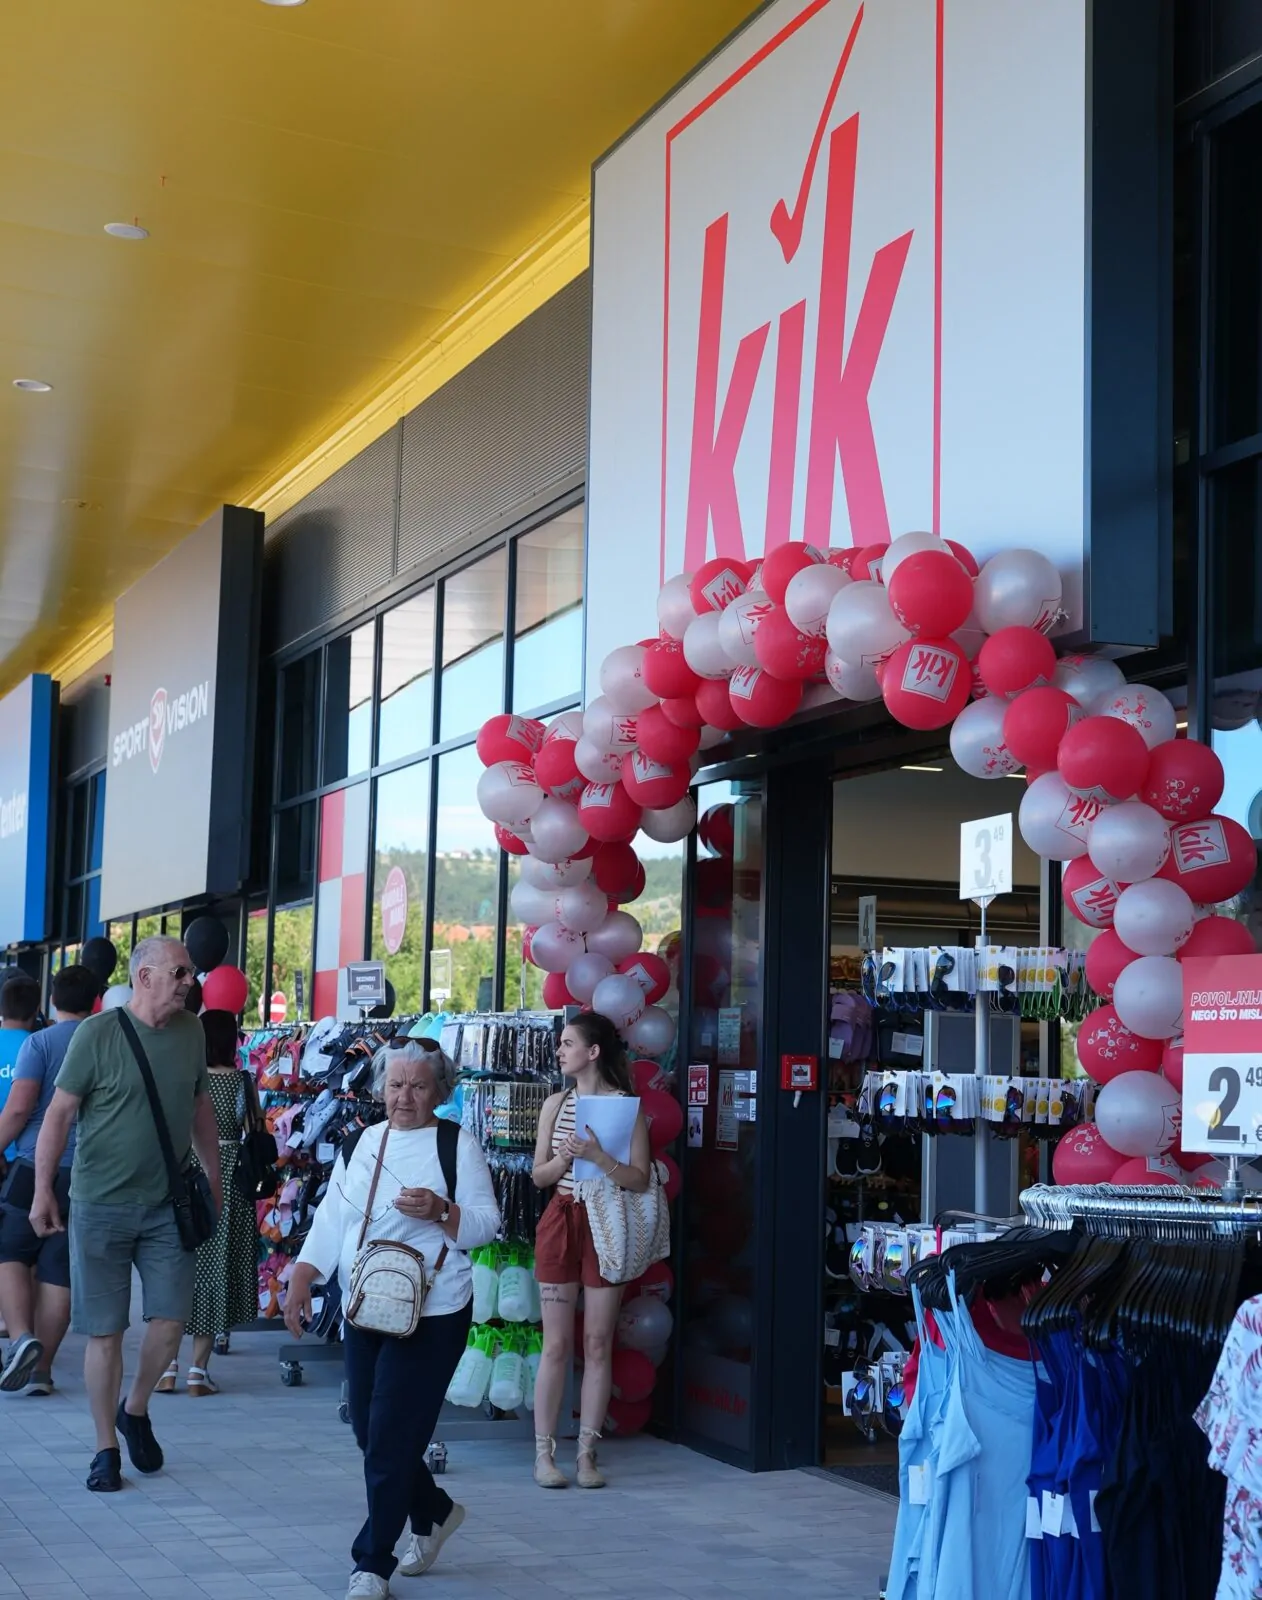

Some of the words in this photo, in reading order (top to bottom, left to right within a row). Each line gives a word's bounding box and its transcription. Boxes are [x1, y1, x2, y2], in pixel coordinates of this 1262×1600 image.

[683, 3, 914, 572] kik
[912, 650, 954, 688] kik
[112, 716, 149, 767] SPORT
[167, 681, 209, 736] VISION
[1178, 826, 1221, 864] kik
[1190, 990, 1262, 1007] POVOLJNIJ
[1191, 1009, 1218, 1021] NEGO
[1219, 1007, 1237, 1021] ŠTO
[1239, 1008, 1262, 1020] MISL
[1245, 1066, 1262, 1087] 49
